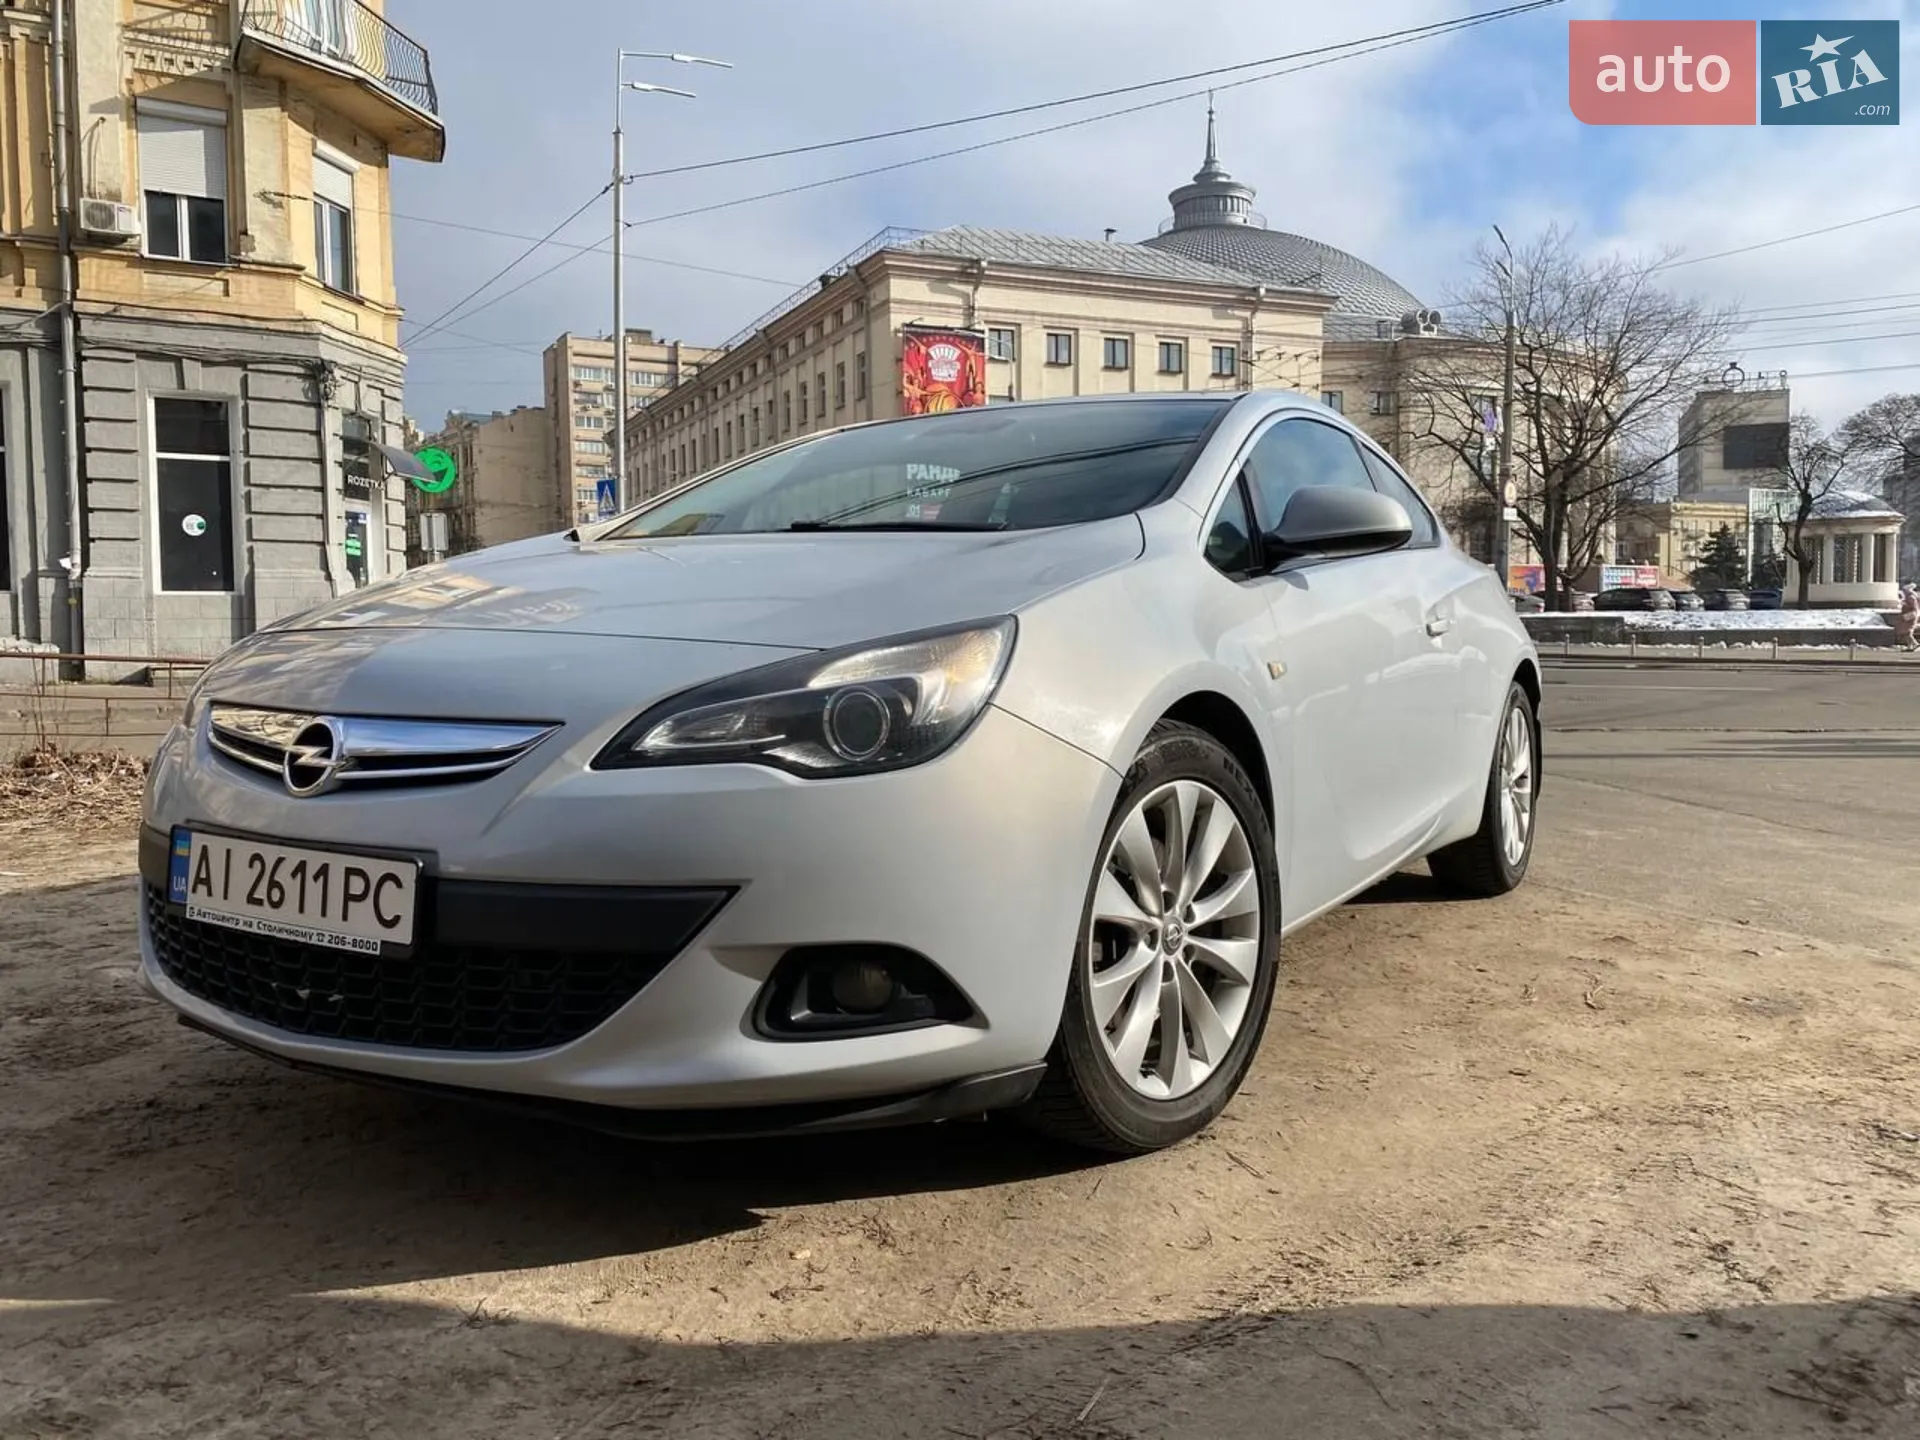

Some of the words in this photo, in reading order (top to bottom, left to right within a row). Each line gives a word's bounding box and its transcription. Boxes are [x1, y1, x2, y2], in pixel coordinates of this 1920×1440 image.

[347, 474, 385, 492] ROZETKA
[173, 875, 187, 892] UA
[191, 844, 231, 901] AI
[246, 852, 331, 918] 2611
[341, 866, 403, 929] PC
[196, 908, 240, 926] Автоцентр
[243, 920, 253, 929] на
[256, 921, 314, 941] Столичному
[327, 934, 379, 952] 206-8000
